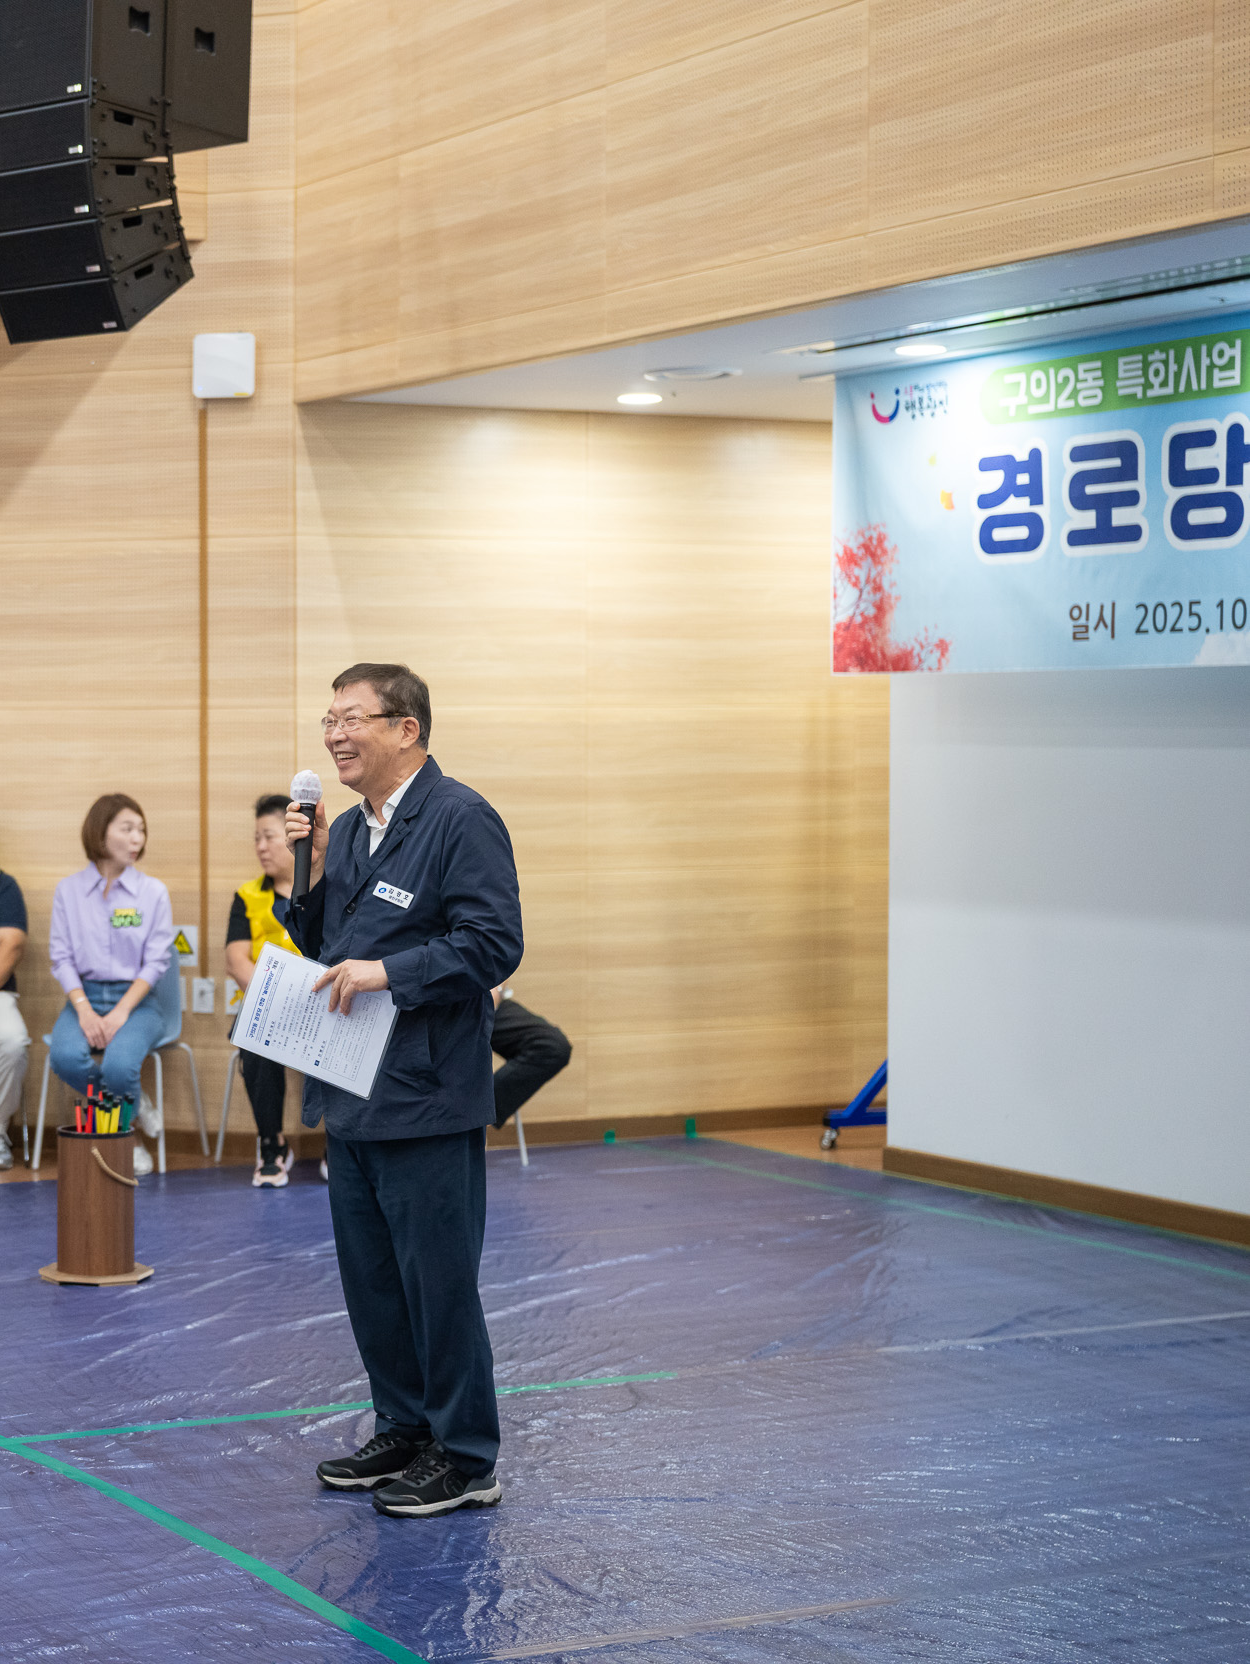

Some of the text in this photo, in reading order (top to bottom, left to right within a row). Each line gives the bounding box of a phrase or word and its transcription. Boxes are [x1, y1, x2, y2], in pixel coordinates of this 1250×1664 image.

[1000, 339, 1242, 417] 구의2동 특화사업
[976, 421, 1250, 556] 경로당
[1068, 597, 1248, 641] 일시 2025.10
